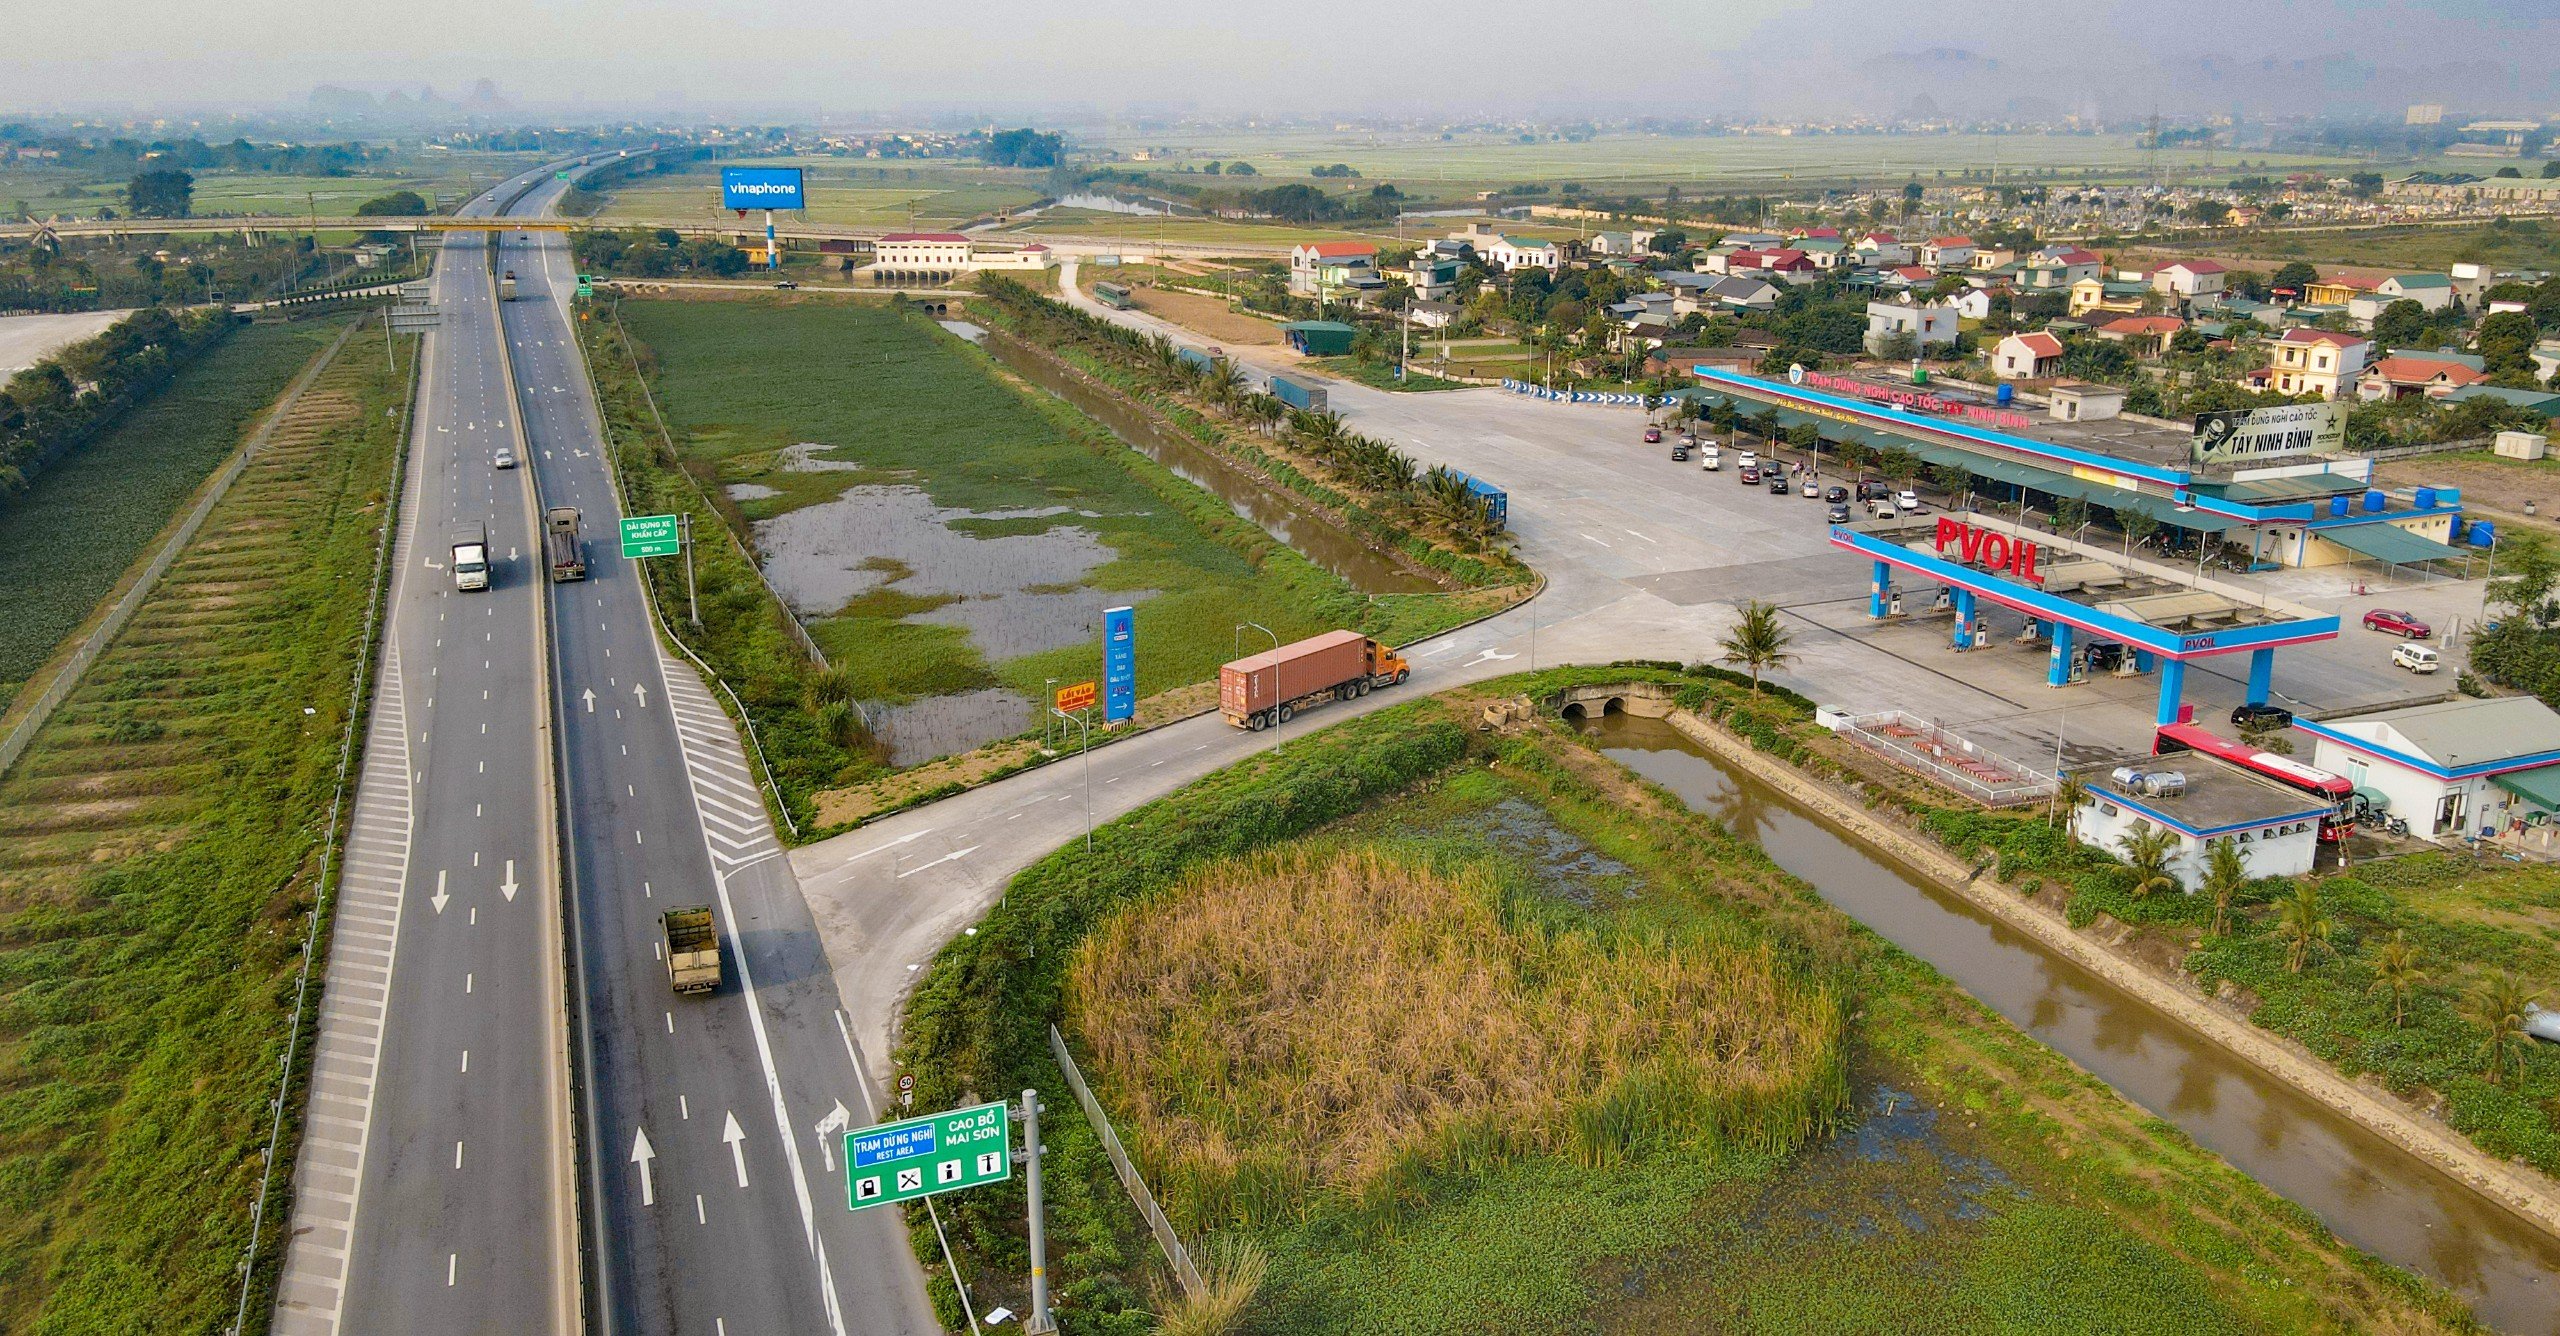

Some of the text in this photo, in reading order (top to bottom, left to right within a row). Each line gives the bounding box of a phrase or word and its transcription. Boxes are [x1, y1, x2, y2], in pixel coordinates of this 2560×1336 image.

[729, 181, 796, 196] vinaphone
[1890, 390, 1914, 405] CAO
[1967, 406, 1997, 423] NINH
[2289, 412, 2304, 422] CAO
[2231, 431, 2253, 455] TÂY
[2254, 432, 2284, 453] NINH
[1833, 529, 1855, 544] PVOIL
[1935, 516, 2045, 584] PVOIL
[2184, 637, 2216, 652] PVOIL
[901, 1077, 912, 1087] 50
[948, 1117, 975, 1132] CAO
[855, 1125, 933, 1154] TRẠM DỪNG NGHỈ
[945, 1126, 1000, 1147] MAI SƠN
[876, 1146, 914, 1161] REST AREA
